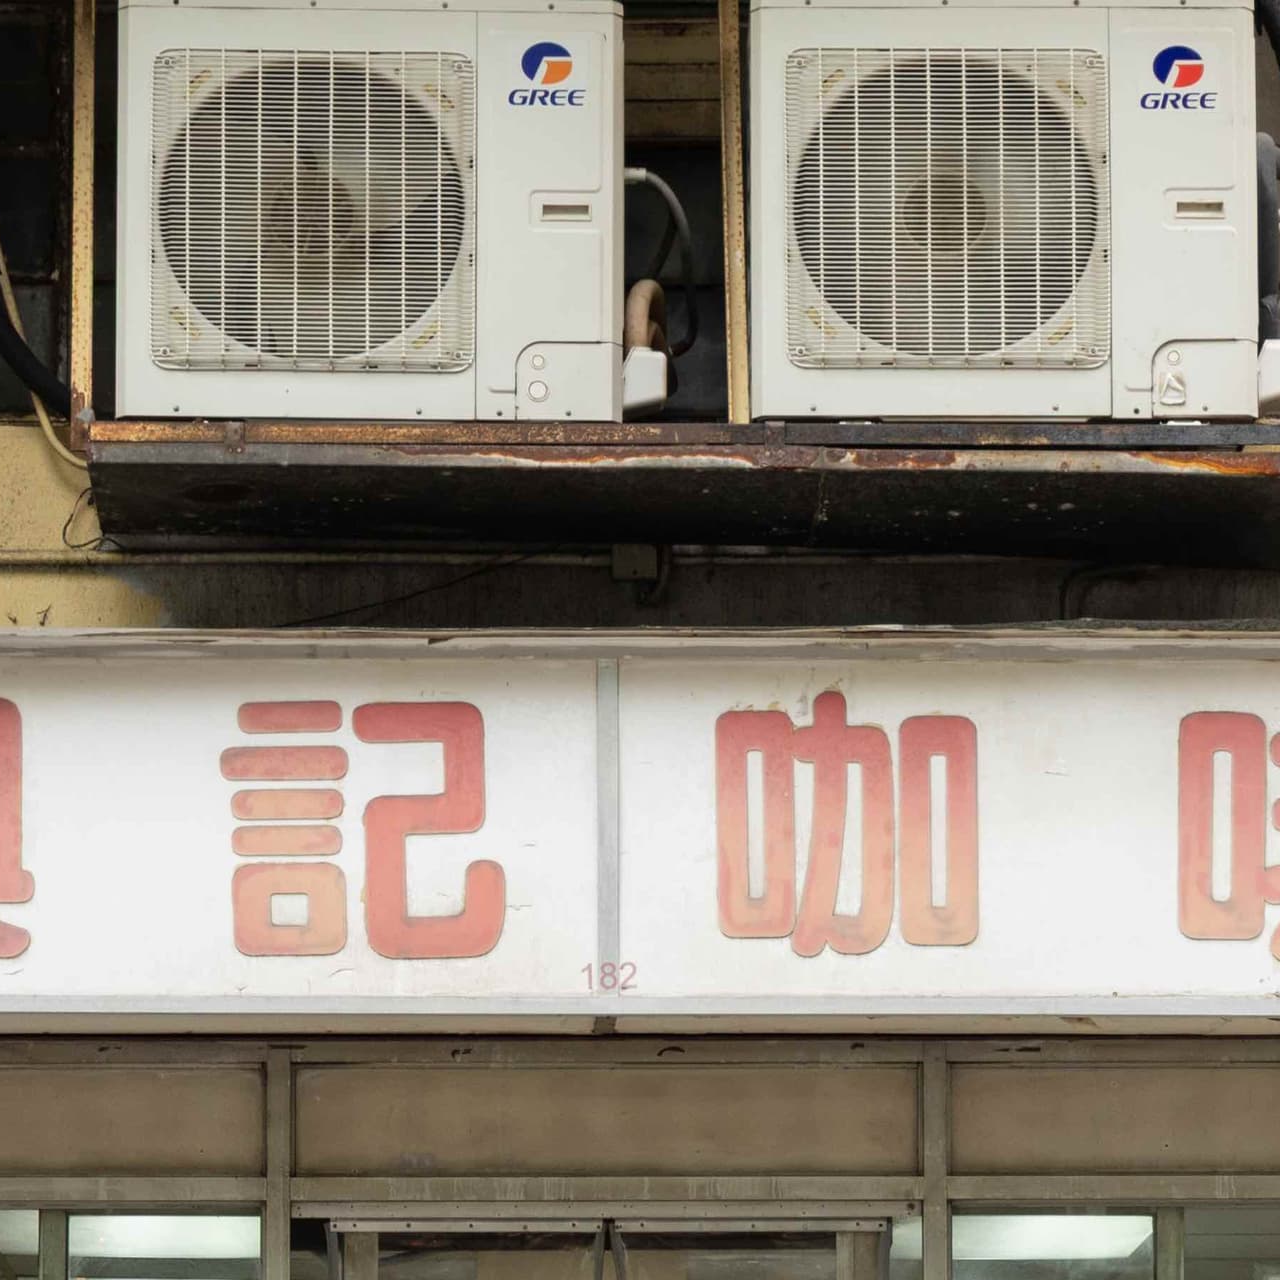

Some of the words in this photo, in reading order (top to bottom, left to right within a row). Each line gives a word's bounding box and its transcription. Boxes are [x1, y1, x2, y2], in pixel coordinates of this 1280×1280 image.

[508, 89, 586, 106] GREE
[1140, 92, 1218, 109] GREE
[580, 961, 637, 991] 182
